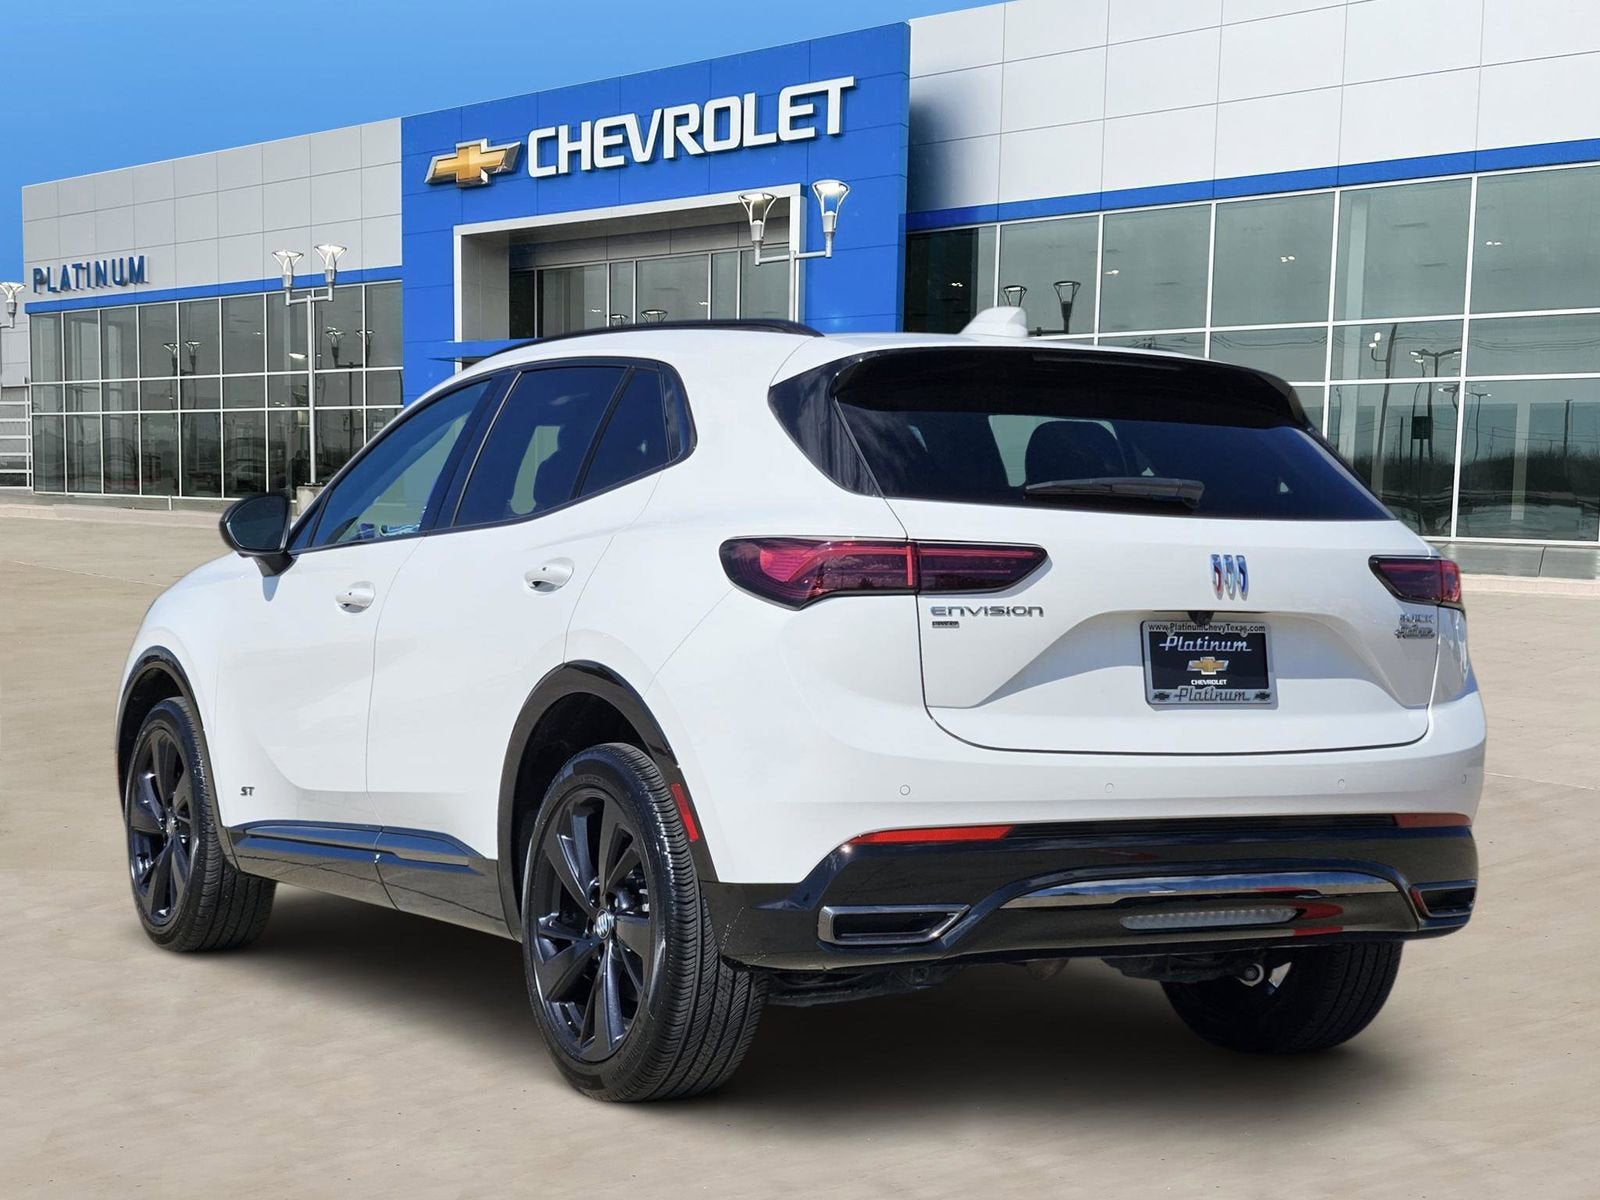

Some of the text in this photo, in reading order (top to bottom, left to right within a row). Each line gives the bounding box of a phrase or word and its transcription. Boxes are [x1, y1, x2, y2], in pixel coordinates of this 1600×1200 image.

[527, 75, 857, 178] CHEVROLET
[33, 255, 145, 293] PLATINUM
[1159, 636, 1252, 651] Platinum
[1174, 686, 1251, 702] Platinum
[240, 786, 255, 796] ST
